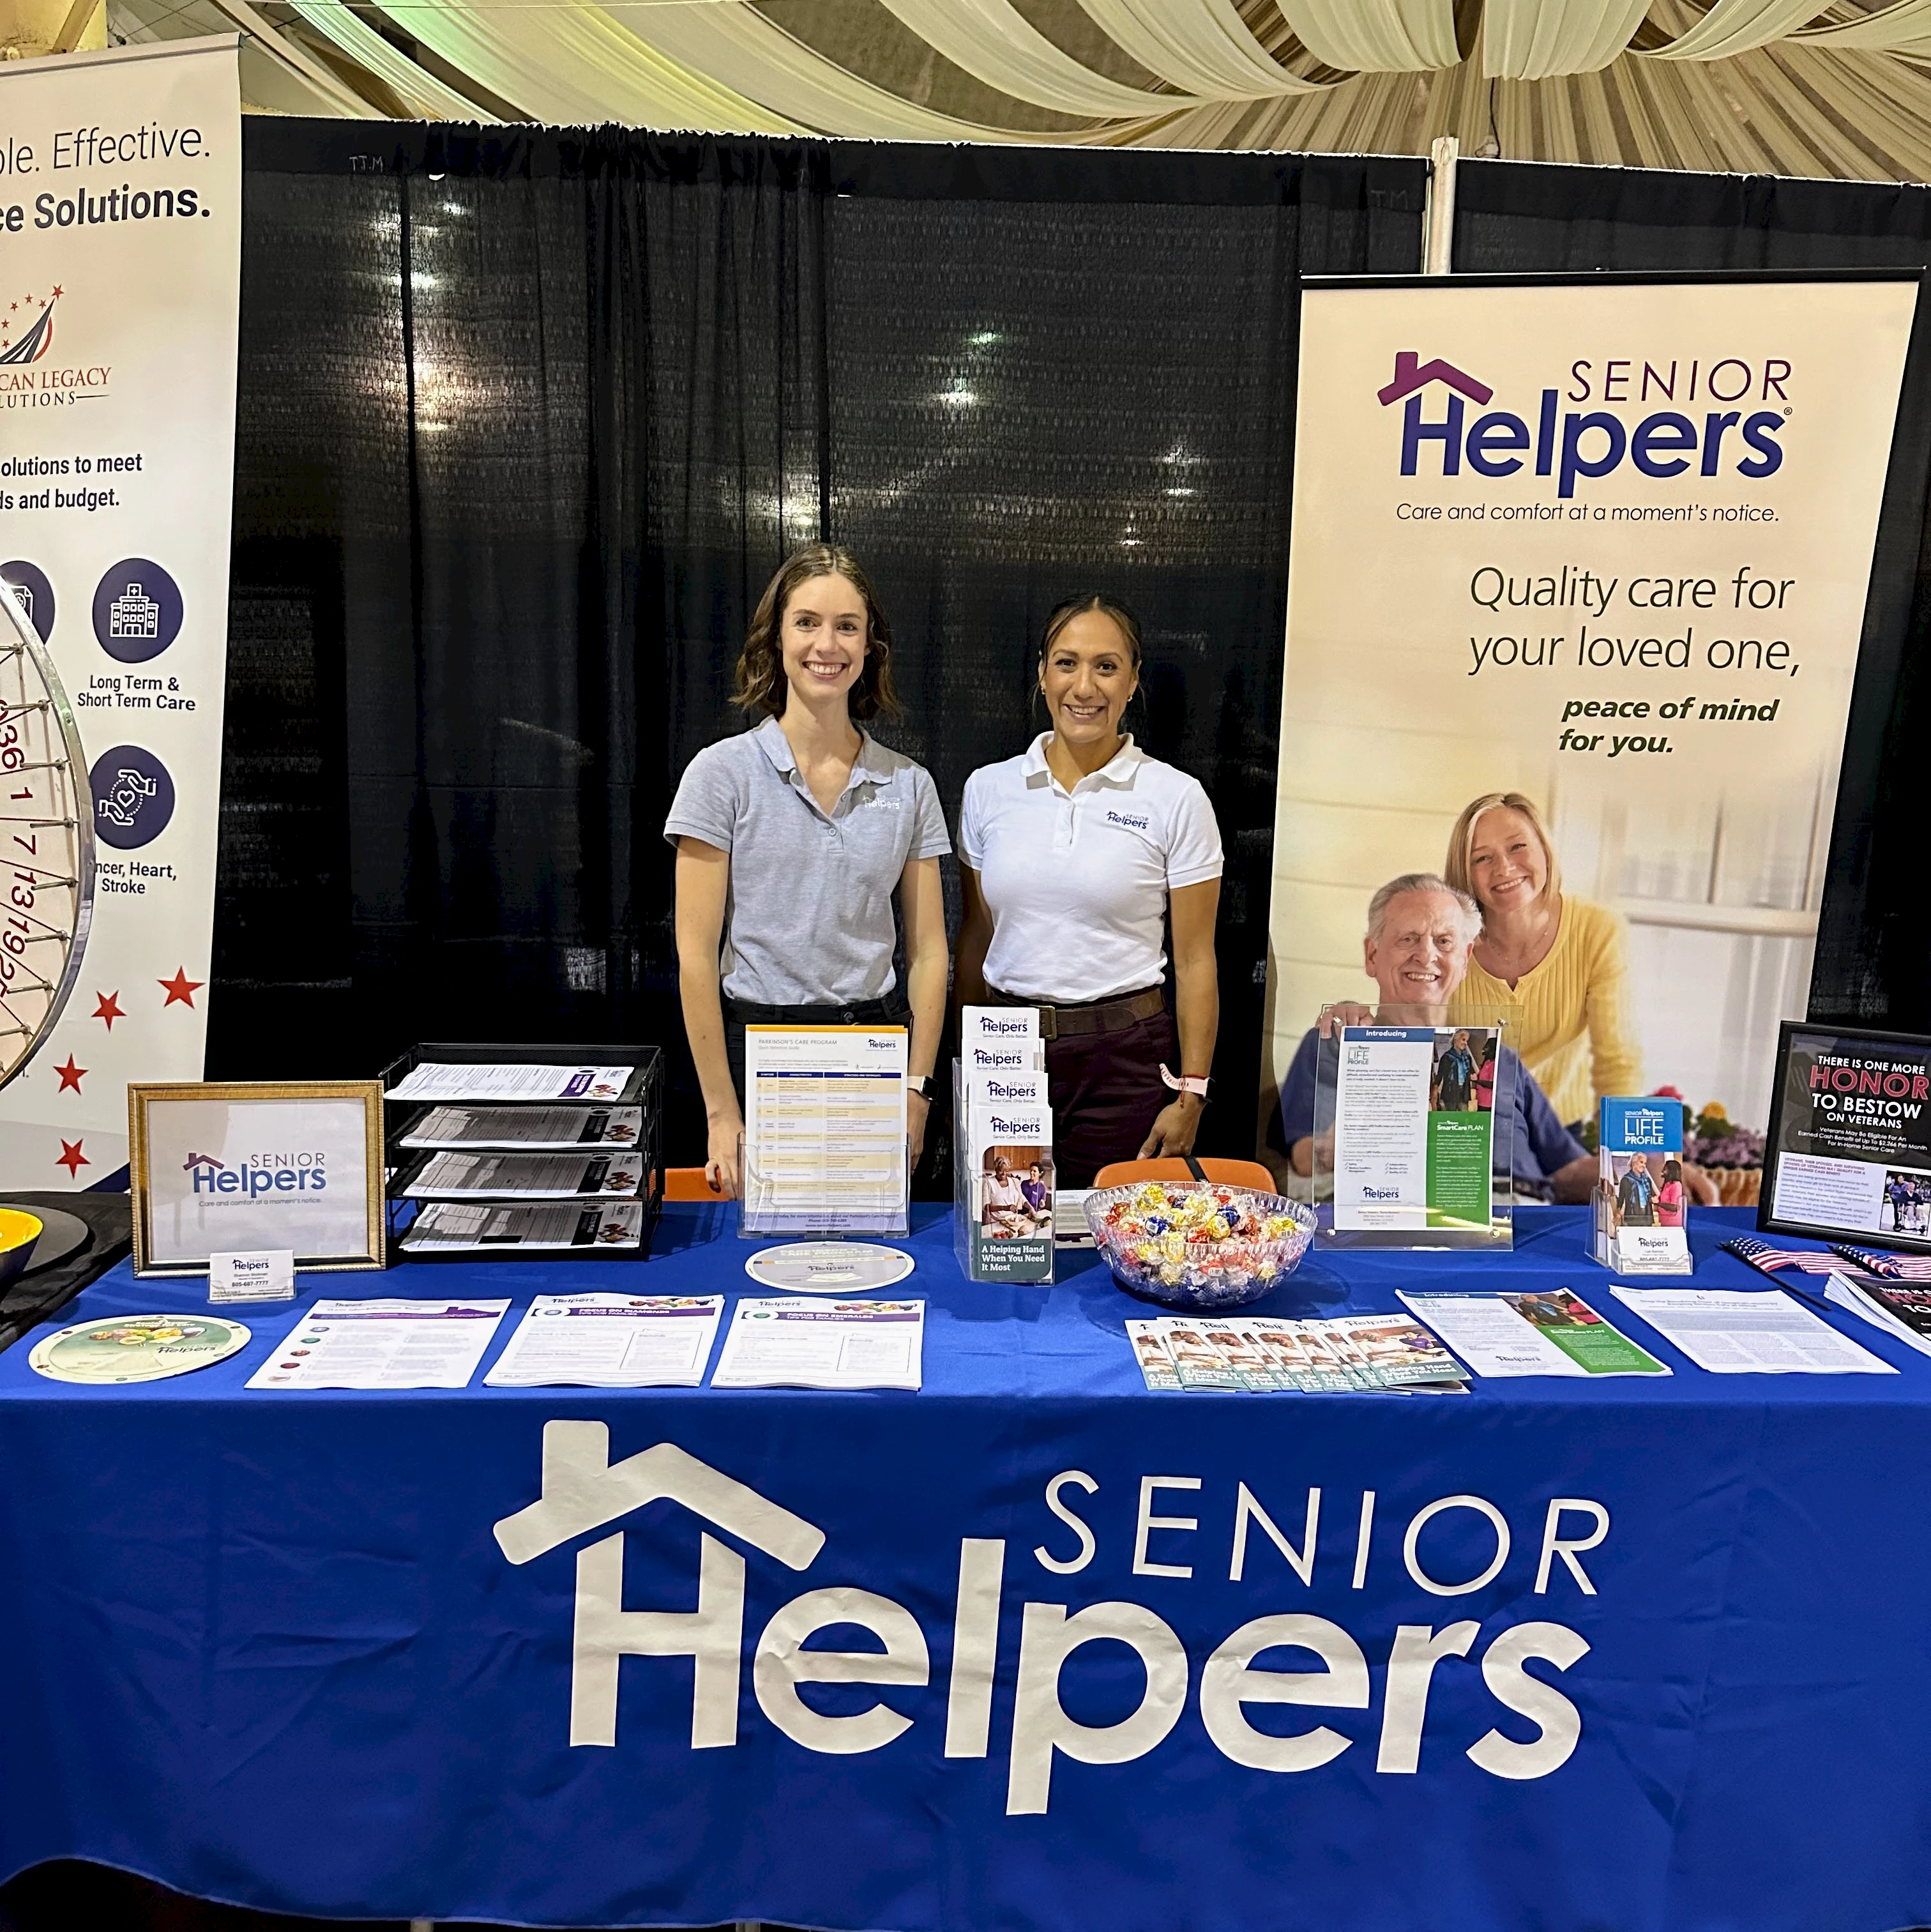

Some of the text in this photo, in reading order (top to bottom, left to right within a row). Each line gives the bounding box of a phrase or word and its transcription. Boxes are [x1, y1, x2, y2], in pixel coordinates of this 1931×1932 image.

[54, 121, 211, 169] Effective.
[34, 183, 211, 229] Solutions.
[42, 367, 112, 390] LEGACY
[1568, 359, 1790, 402] SENIOR
[75, 456, 91, 473] to
[97, 453, 142, 473] meet
[19, 489, 50, 509] and
[55, 487, 119, 512] budget.
[1397, 502, 1780, 522] Care and comfort at a moment's notice.
[1470, 566, 1795, 617] Quality care for
[1468, 627, 1800, 677] your loved one,
[90, 674, 179, 692] Long Term &
[77, 692, 196, 711] Short Term Care
[1561, 697, 1779, 722] peace of mind
[1559, 730, 1674, 756] for you.
[10, 786, 33, 800] 1
[1107, 814, 1148, 830] Helpers
[13, 834, 36, 855] 7
[130, 862, 177, 881] Heart,
[11, 872, 37, 909] 13
[102, 878, 146, 894] Stroke
[3, 917, 30, 955] 19
[983, 1021, 1028, 1034] Helpers
[1365, 1030, 1407, 1038] Introducing
[870, 1041, 896, 1049] Helpers
[976, 1053, 1022, 1066] Helpers
[1348, 1050, 1369, 1060] LIFE
[1818, 1055, 1925, 1075] THERE IS ONE MORE
[1809, 1065, 1930, 1100] HONOR
[989, 1085, 1036, 1099] Helpers
[1812, 1093, 1922, 1119] TO BESTOW
[993, 1121, 1040, 1135] Helpers
[1624, 1118, 1664, 1136] LIFE
[1826, 1112, 1902, 1129] ON VETERANS
[1624, 1136, 1664, 1145] PROFILE
[1867, 1132, 1888, 1140] Eligible
[1836, 1141, 1861, 1150] In-Home
[250, 1152, 324, 1168] SENIOR
[193, 1163, 327, 1198] Helpers
[1365, 1190, 1399, 1200] Helpers
[989, 1245, 1021, 1254] Helping
[1022, 1245, 1045, 1253] Hand
[1640, 1240, 1669, 1248] Helpers
[234, 1261, 269, 1270] Helpers
[981, 1254, 1006, 1262] When
[1008, 1254, 1024, 1263] You
[1031, 1470, 1612, 1598] SENIOR
[570, 1530, 1595, 1816] Helpers
